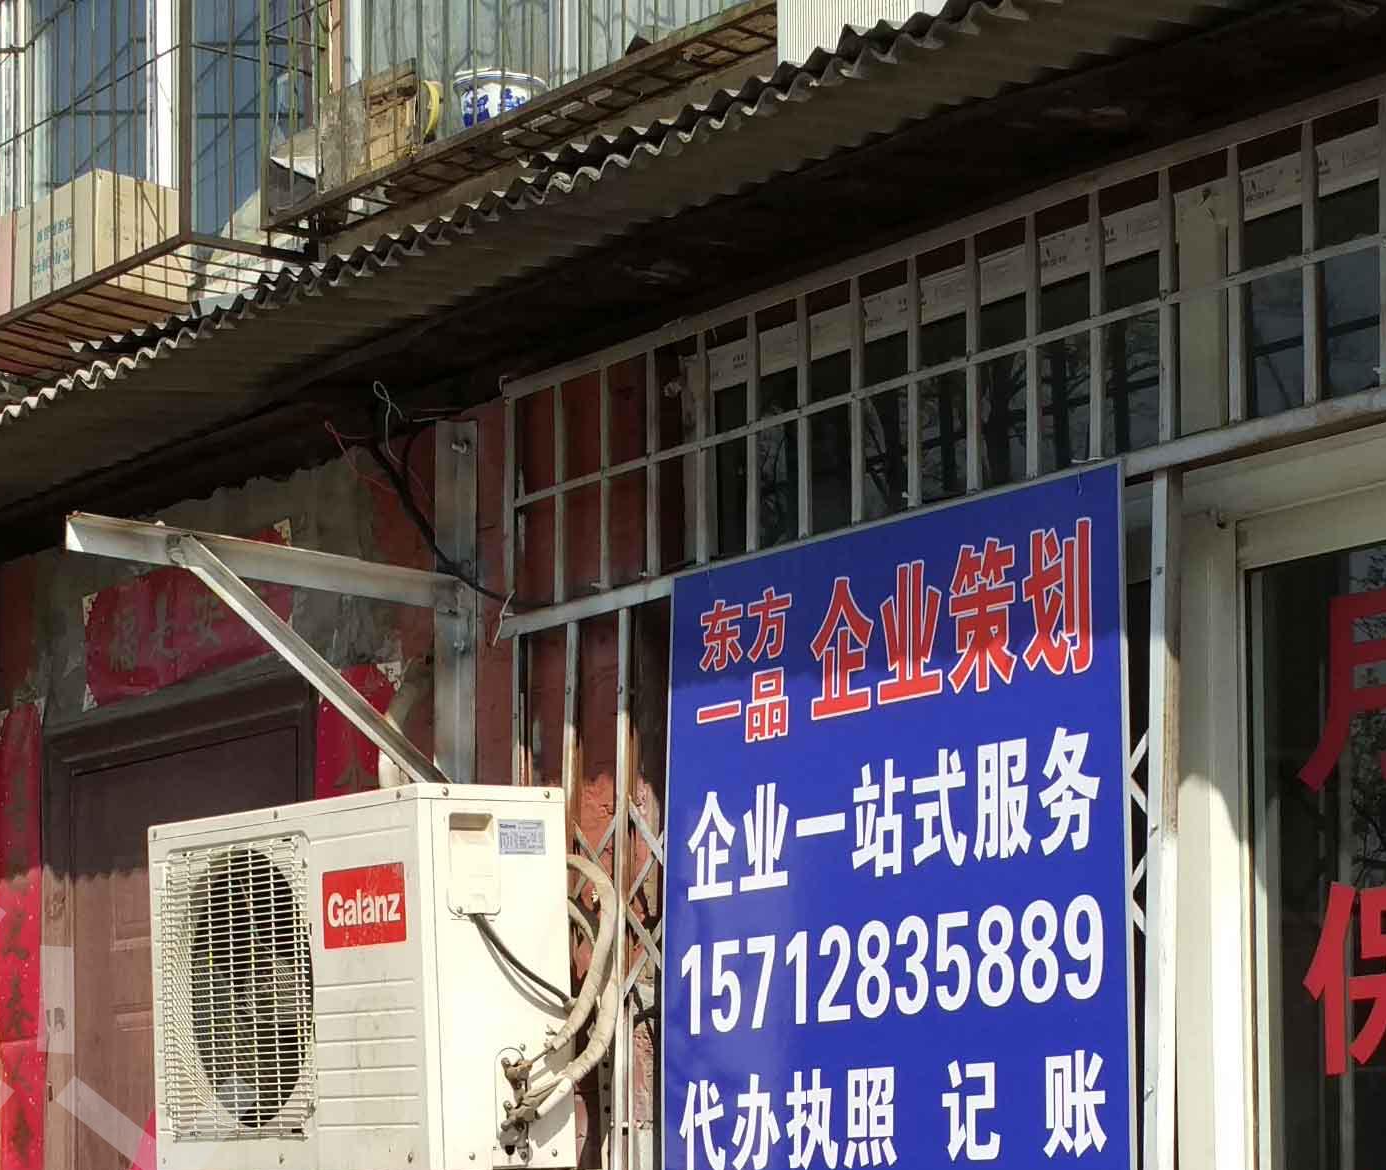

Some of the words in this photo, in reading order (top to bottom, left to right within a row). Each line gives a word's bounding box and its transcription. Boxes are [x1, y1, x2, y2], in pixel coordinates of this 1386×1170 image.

[699, 586, 792, 671] 东方
[811, 517, 1092, 720] 企业策划
[697, 667, 789, 742] 一品
[687, 727, 1100, 901] 企业一站式服务
[327, 892, 401, 928] Galanz
[681, 894, 1104, 1035] 15712835889
[941, 1049, 1107, 1162] 记账
